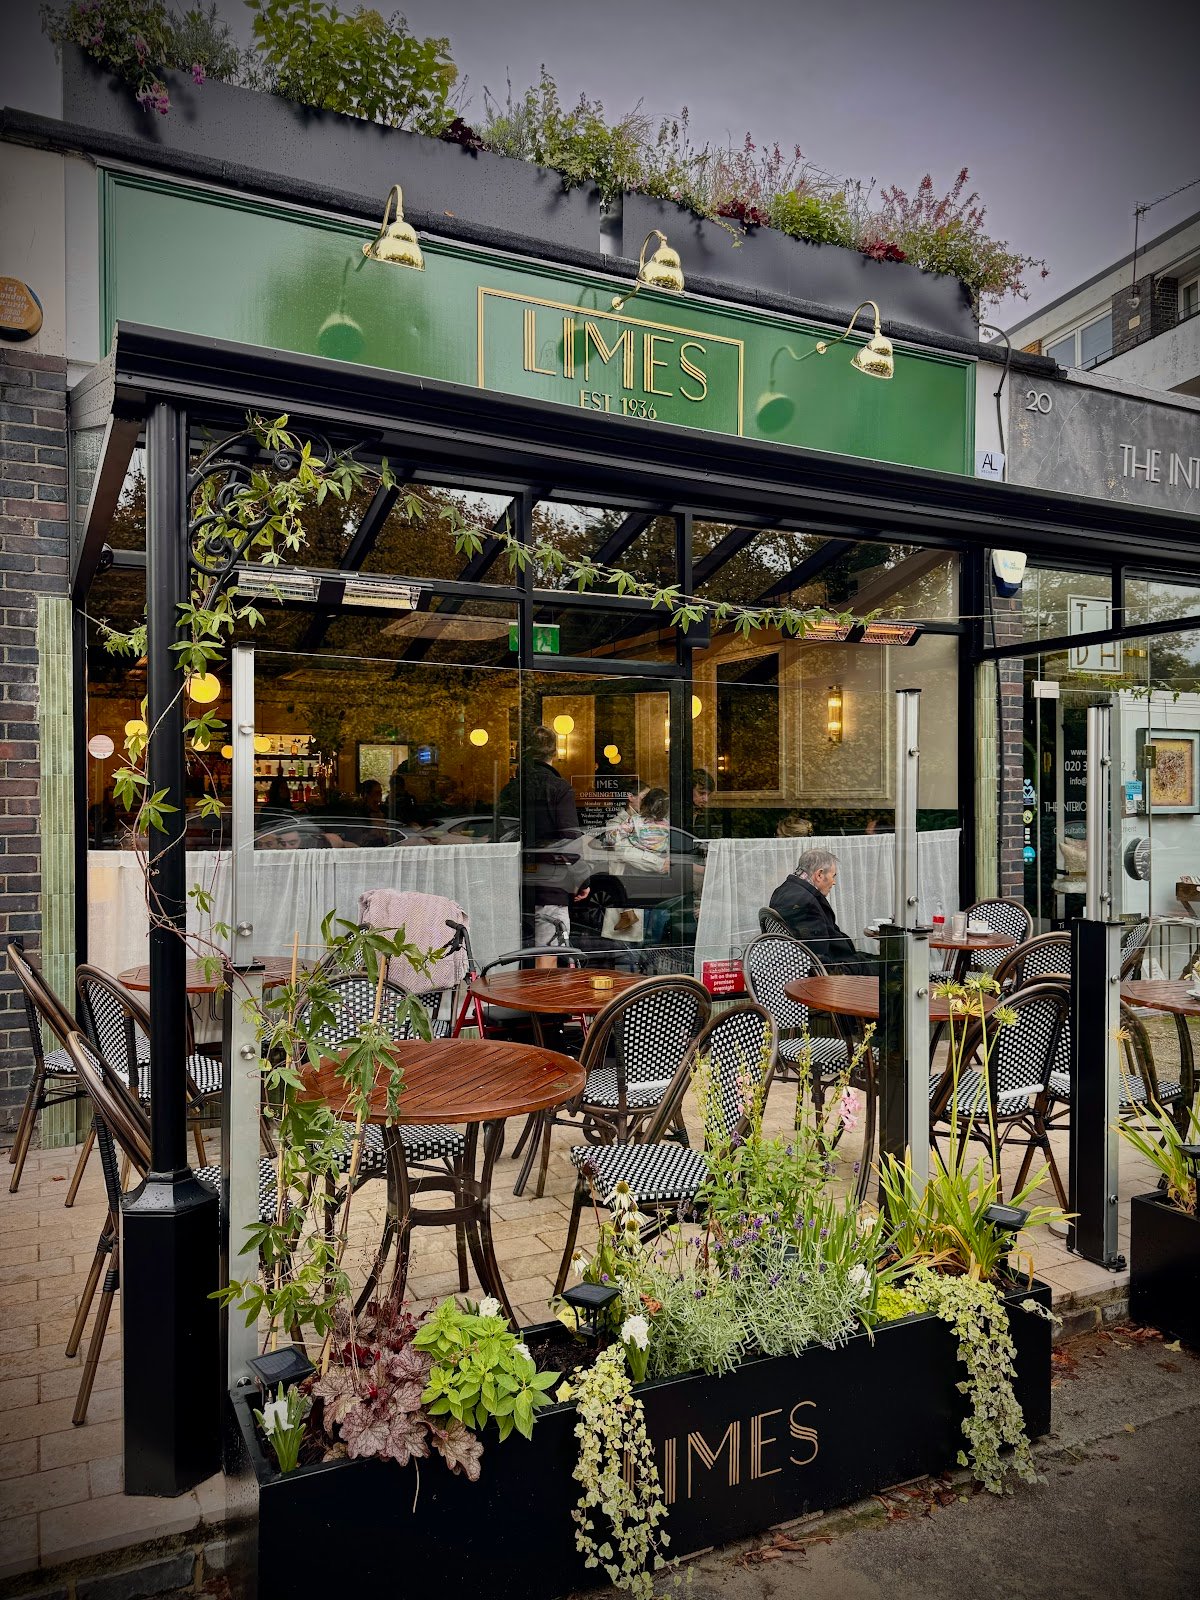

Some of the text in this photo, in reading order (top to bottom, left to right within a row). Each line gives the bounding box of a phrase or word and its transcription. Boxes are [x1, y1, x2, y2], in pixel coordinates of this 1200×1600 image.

[0, 292, 27, 302] ondon
[523, 308, 707, 401] LIMES
[579, 389, 658, 420] EST 1936
[1025, 389, 1052, 414] 20
[981, 453, 998, 471] AL
[1119, 443, 1162, 483] THE
[1065, 760, 1081, 771] 020
[713, 979, 735, 987] premises
